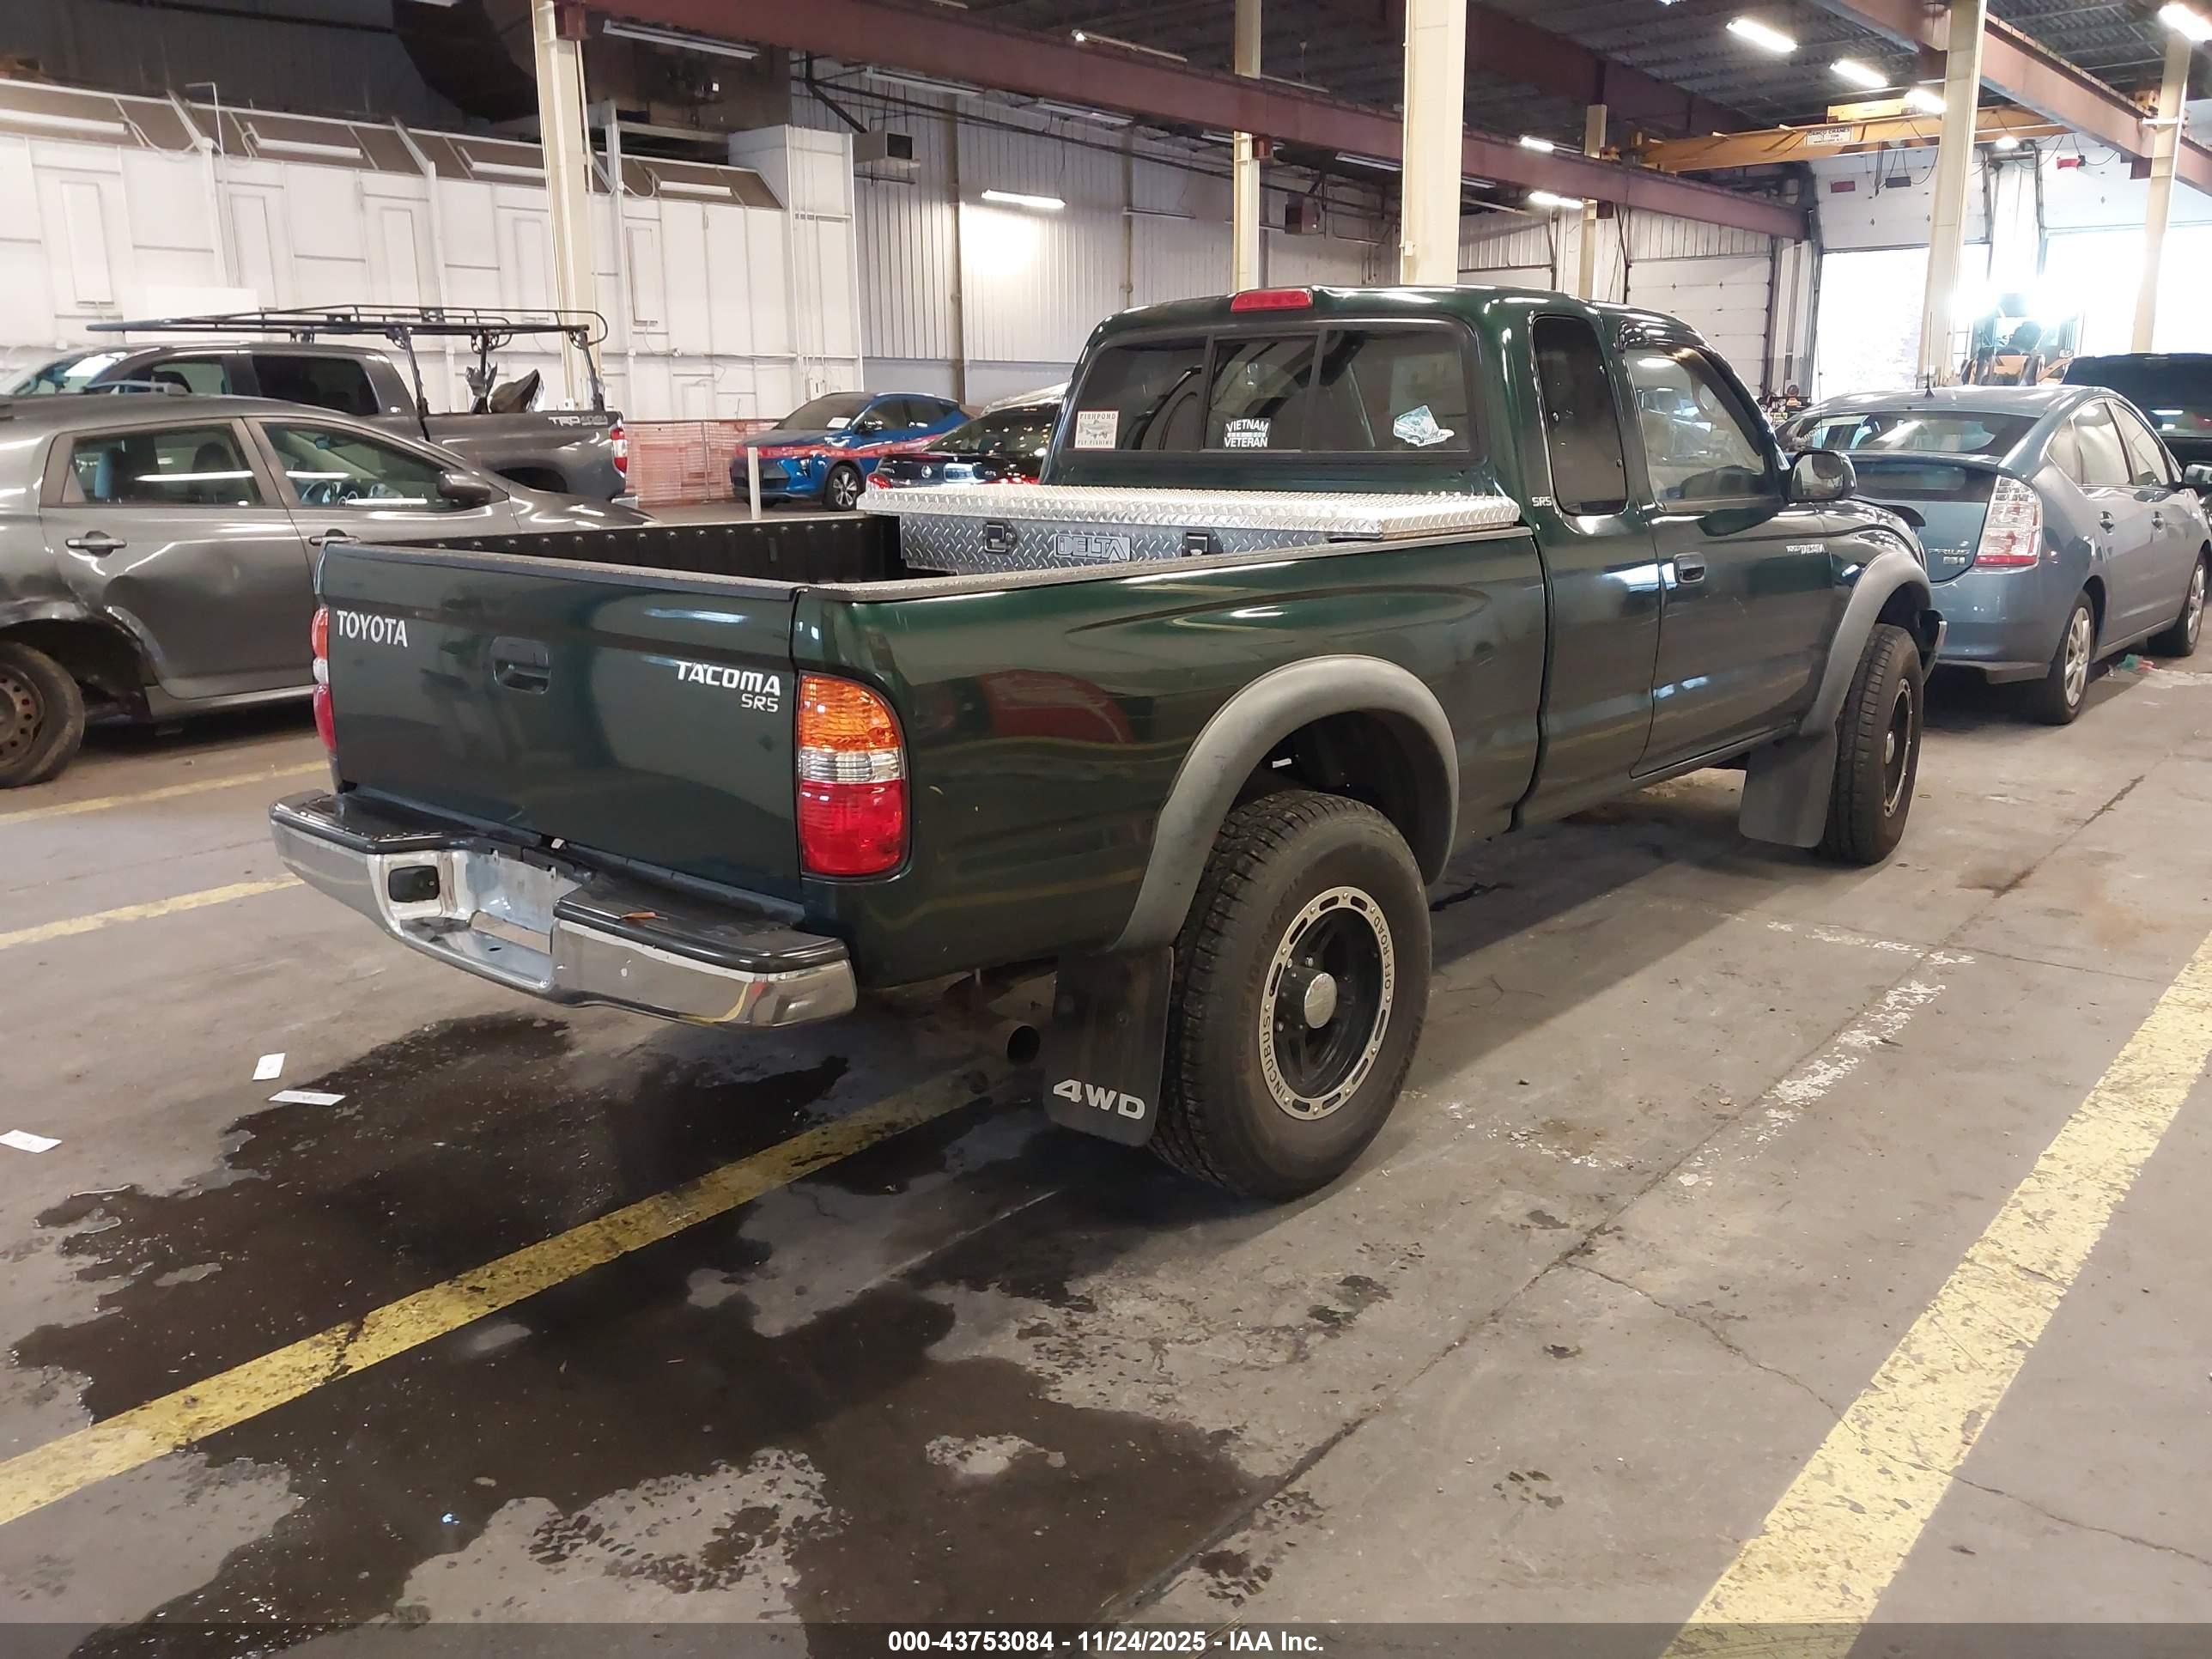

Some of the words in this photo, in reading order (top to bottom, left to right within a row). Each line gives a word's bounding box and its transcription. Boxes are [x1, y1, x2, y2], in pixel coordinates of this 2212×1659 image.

[547, 416, 580, 427] TRD
[1225, 418, 1269, 432] VIETNAM
[1224, 436, 1268, 447] VETERAN
[1056, 535, 1127, 561] DELTA
[336, 610, 408, 648] TOYOTA
[675, 659, 781, 696] TACOMA
[1374, 915, 1393, 991] OFF-ROAD
[1261, 1015, 1284, 1100] INCUBUS
[1053, 1079, 1146, 1120] 4WD
